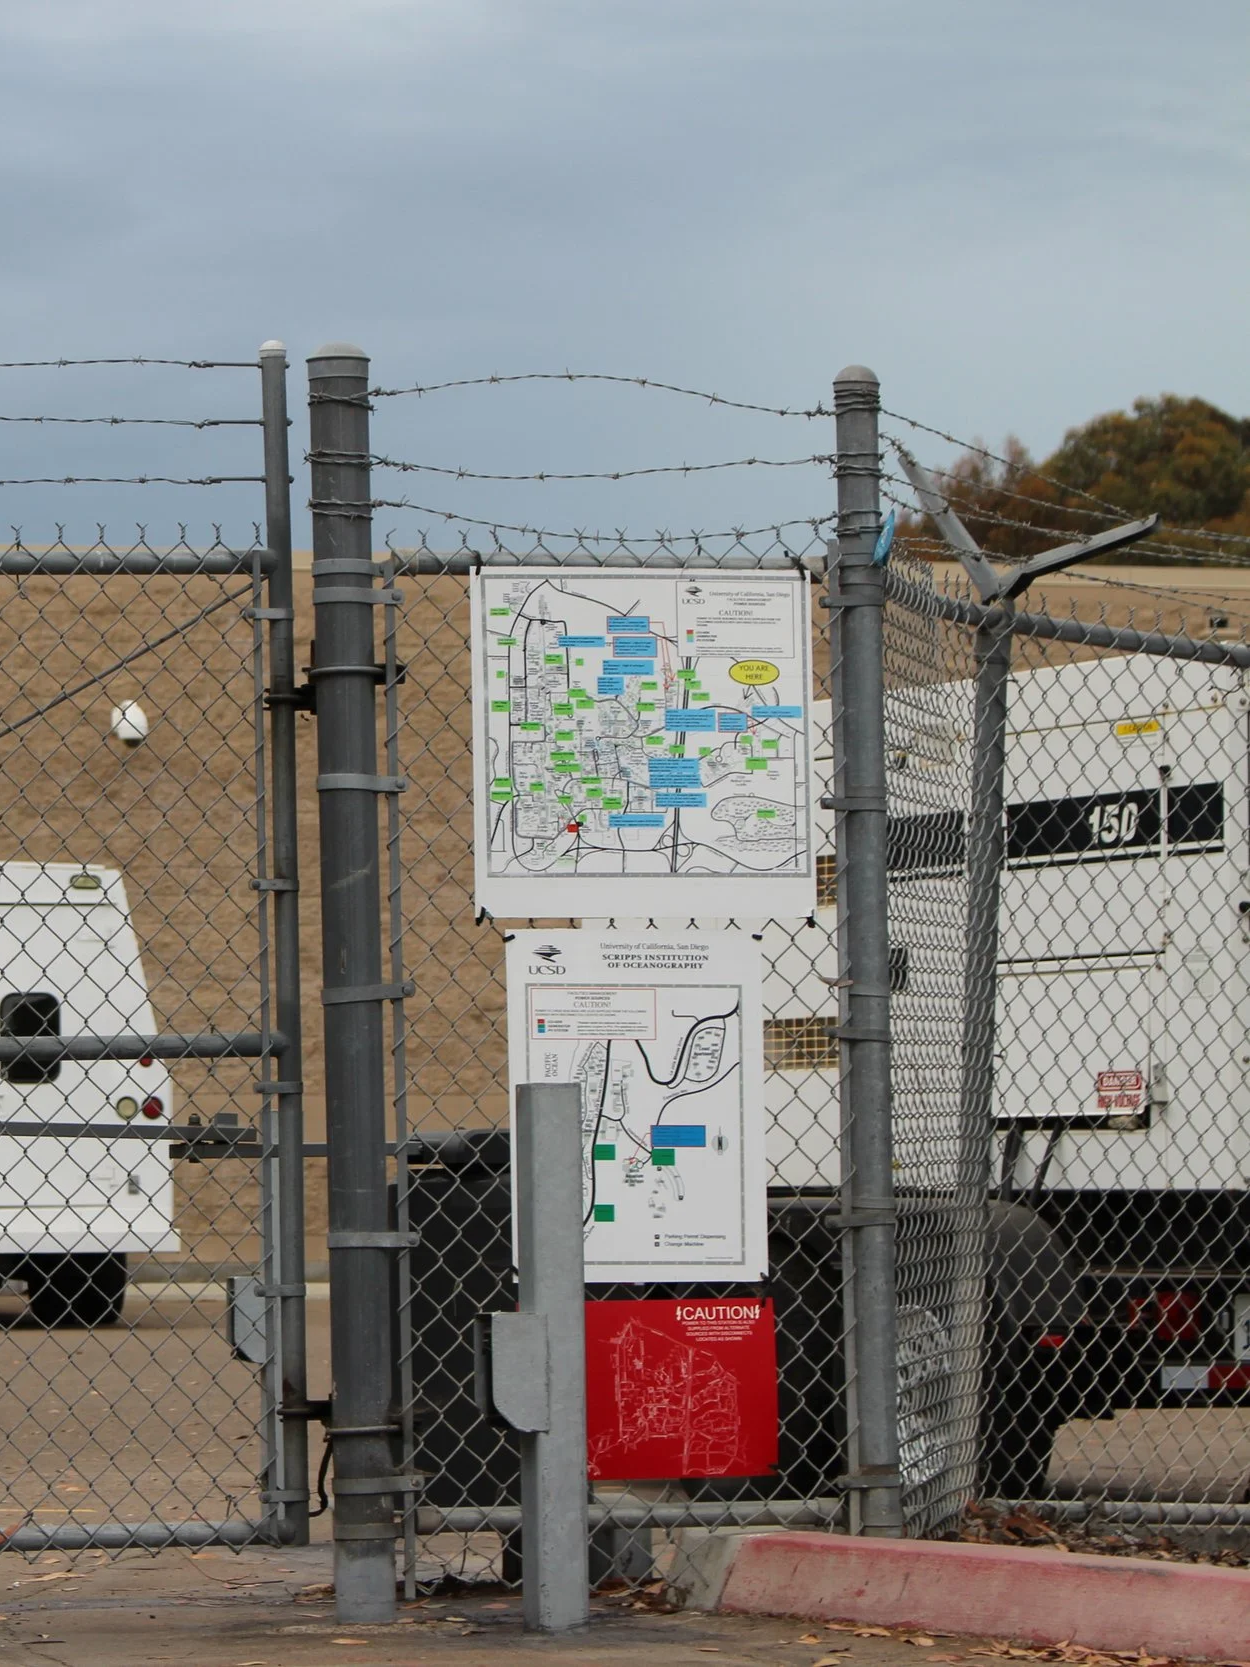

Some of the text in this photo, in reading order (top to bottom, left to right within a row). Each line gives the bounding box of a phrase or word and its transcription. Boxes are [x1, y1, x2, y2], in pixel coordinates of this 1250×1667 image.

[740, 664, 768, 672] YOU ARE
[1088, 802, 1139, 844] 150
[600, 942, 634, 950] University
[690, 944, 709, 952] Diego
[528, 966, 566, 975] UCSD
